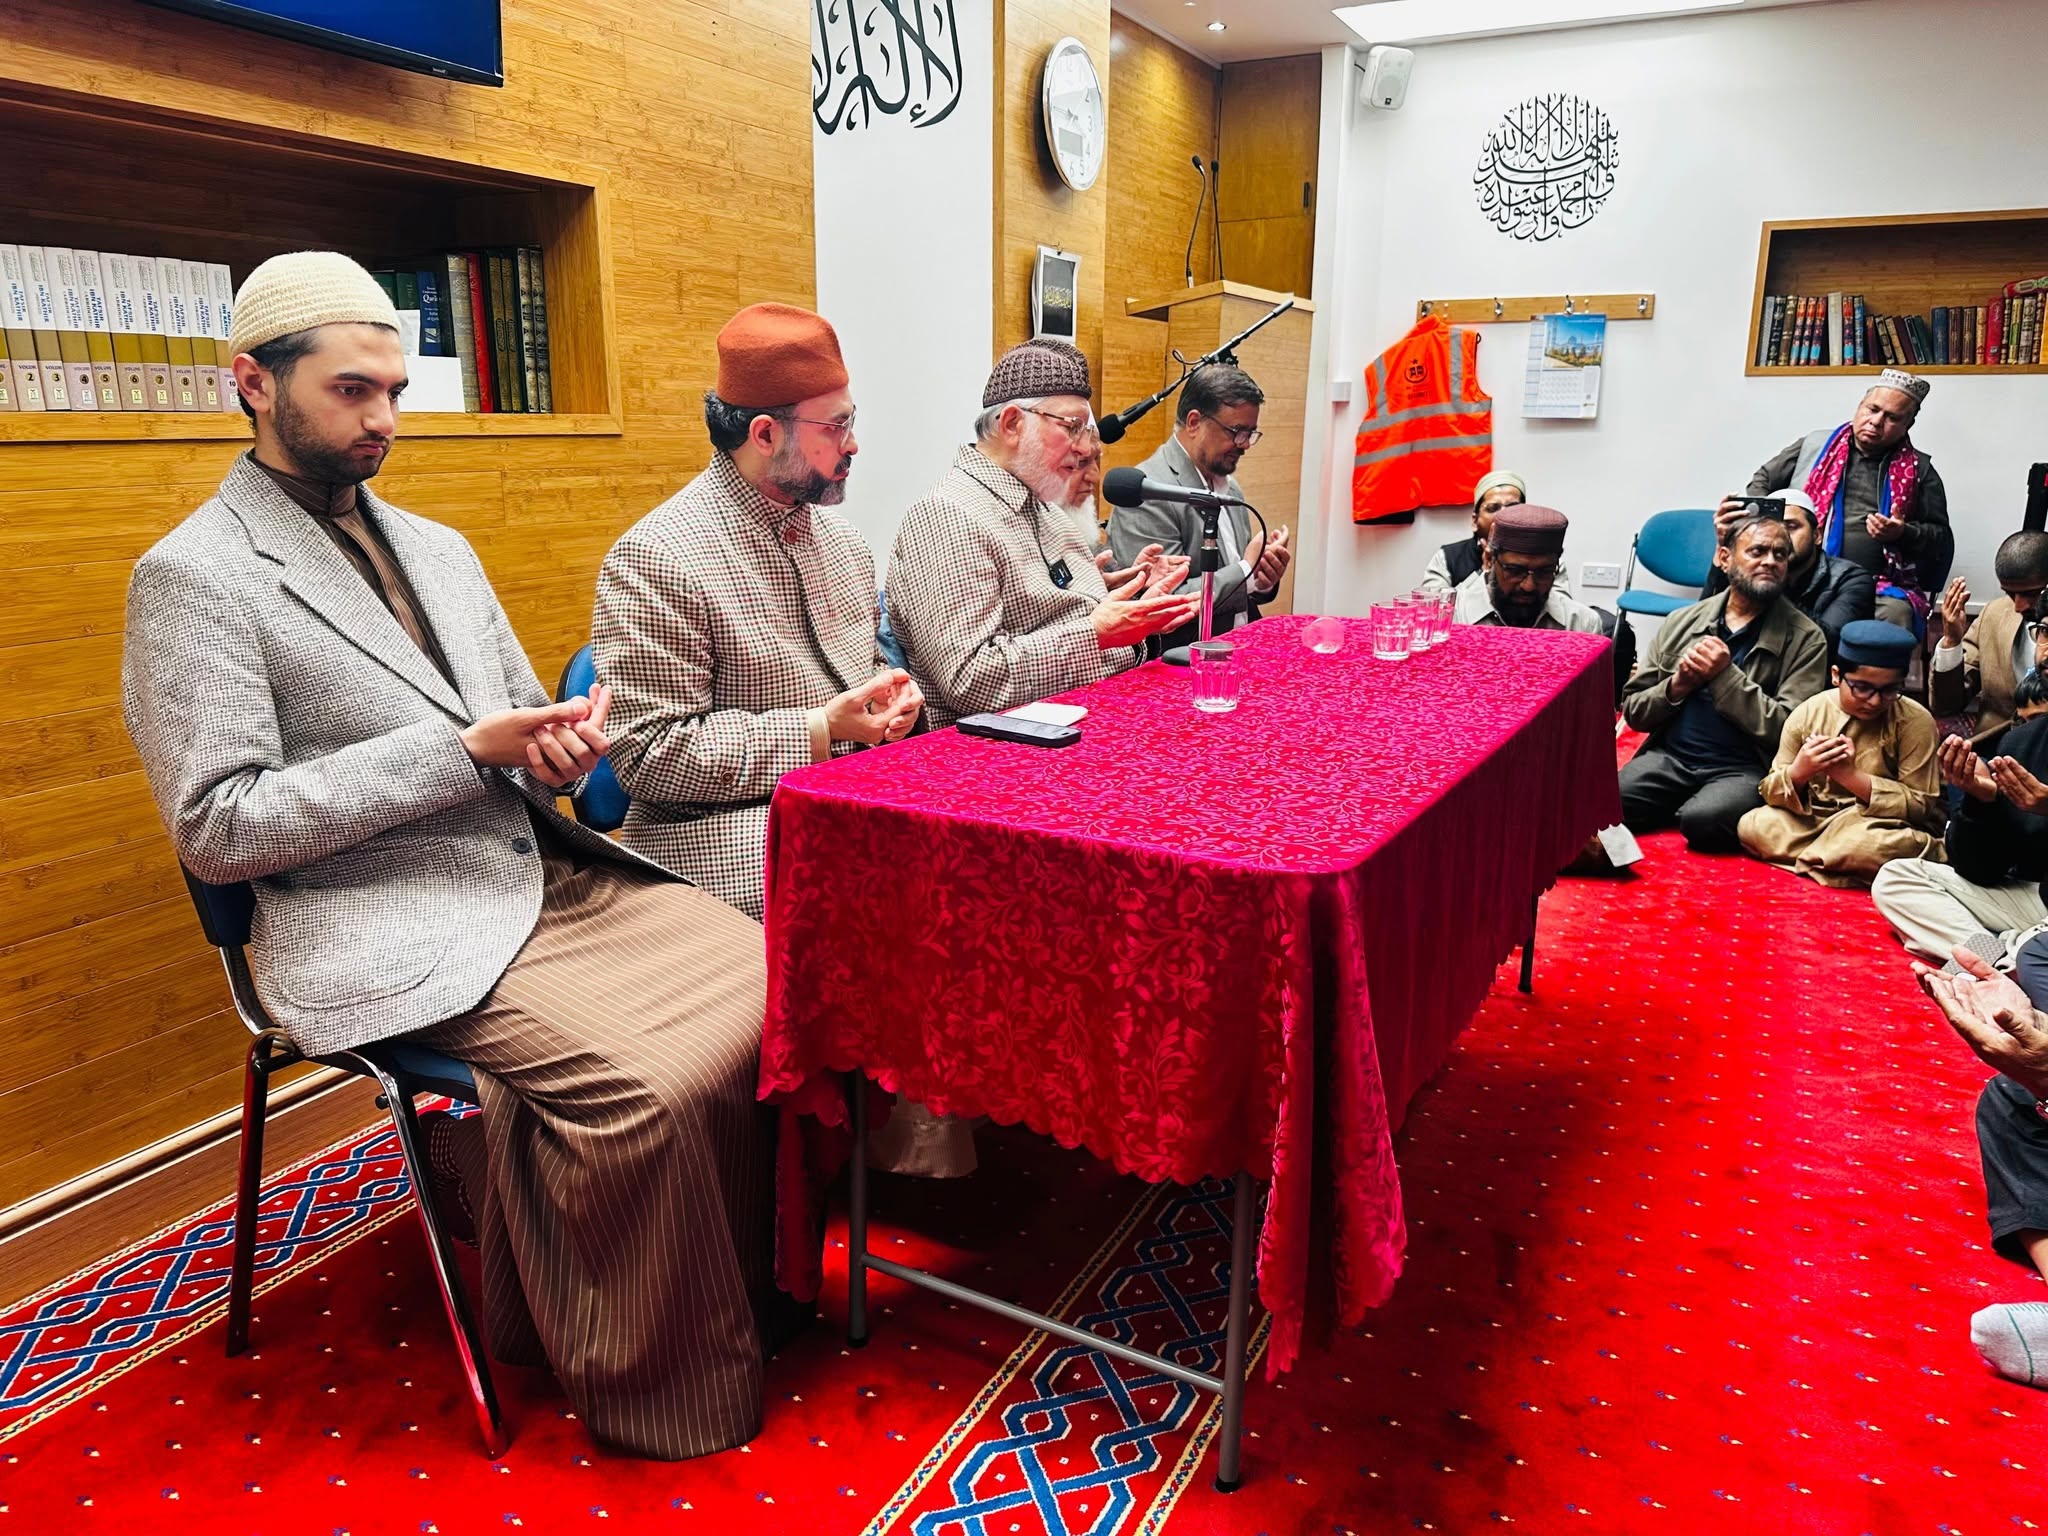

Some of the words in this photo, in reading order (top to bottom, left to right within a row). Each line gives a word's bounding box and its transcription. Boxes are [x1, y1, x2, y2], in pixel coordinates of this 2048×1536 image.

[14, 297, 23, 321] KATHIR
[41, 298, 50, 322] KATHIR
[70, 303, 78, 328] KATHIR
[92, 303, 100, 328] KATHIR
[122, 305, 130, 330] KATHIR
